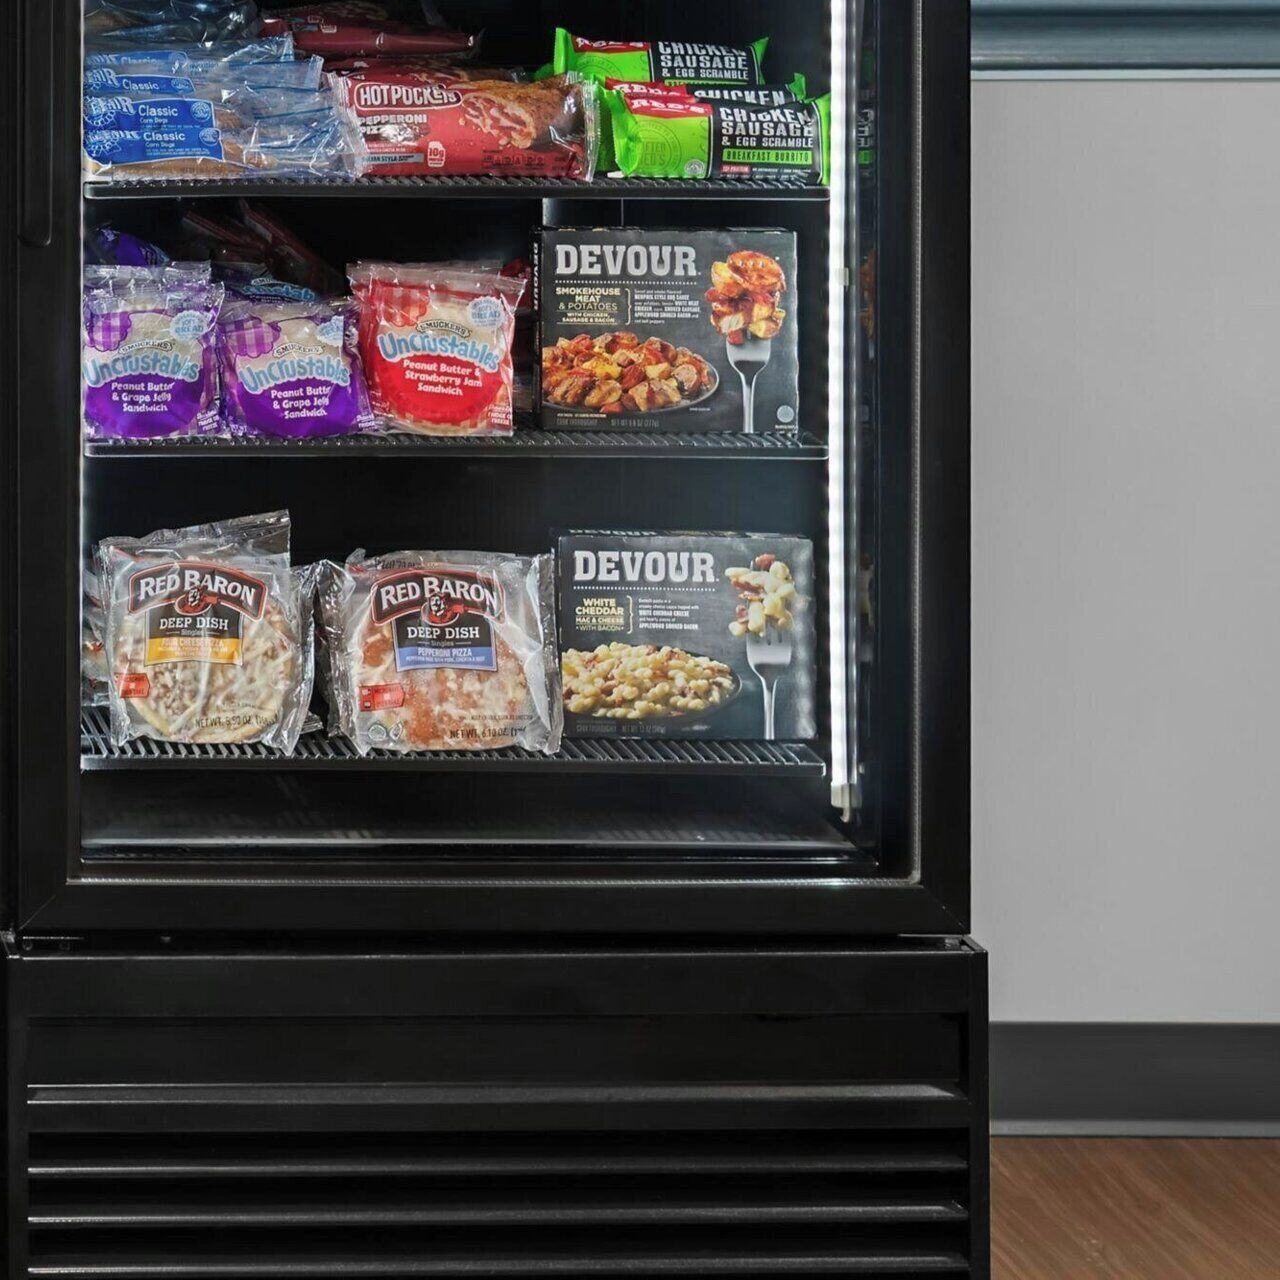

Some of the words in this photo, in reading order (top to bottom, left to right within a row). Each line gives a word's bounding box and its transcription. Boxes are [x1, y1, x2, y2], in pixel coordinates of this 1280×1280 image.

[661, 55, 748, 69] SAUSAGE
[358, 86, 390, 105] HOT
[390, 86, 458, 105] POCKETS
[138, 105, 178, 117] Classic
[721, 121, 814, 137] SAUSAGE
[143, 131, 186, 141] Classic
[726, 149, 771, 162] BREAKFAST
[775, 150, 809, 162] BURRITO
[555, 244, 701, 276] DEVOUR
[556, 288, 621, 296] SMOKEHOUSE
[575, 295, 600, 303] MEAT
[558, 302, 566, 310] &
[568, 302, 617, 311] POTATOES
[380, 333, 500, 371] Uncrustables
[86, 351, 199, 388] Uncrustables
[242, 356, 350, 393] Uncrustables
[405, 371, 462, 386] Strawberry
[463, 377, 483, 387] Jam
[418, 383, 463, 396] Sandwich
[123, 401, 168, 412] Sandwich
[573, 550, 720, 583] DEVOUR
[140, 573, 181, 600] RED
[184, 571, 255, 607] BARON
[380, 580, 421, 609] RED
[423, 579, 498, 614] BARON
[583, 598, 616, 607] WHITE
[575, 607, 624, 616] CHEDDAR
[159, 616, 194, 630] DEEP
[197, 616, 229, 631] DISH
[407, 626, 442, 639] DEEP
[446, 626, 480, 639] DISH
[418, 647, 451, 657] PEPPERONI
[452, 647, 473, 657] PIZZA
